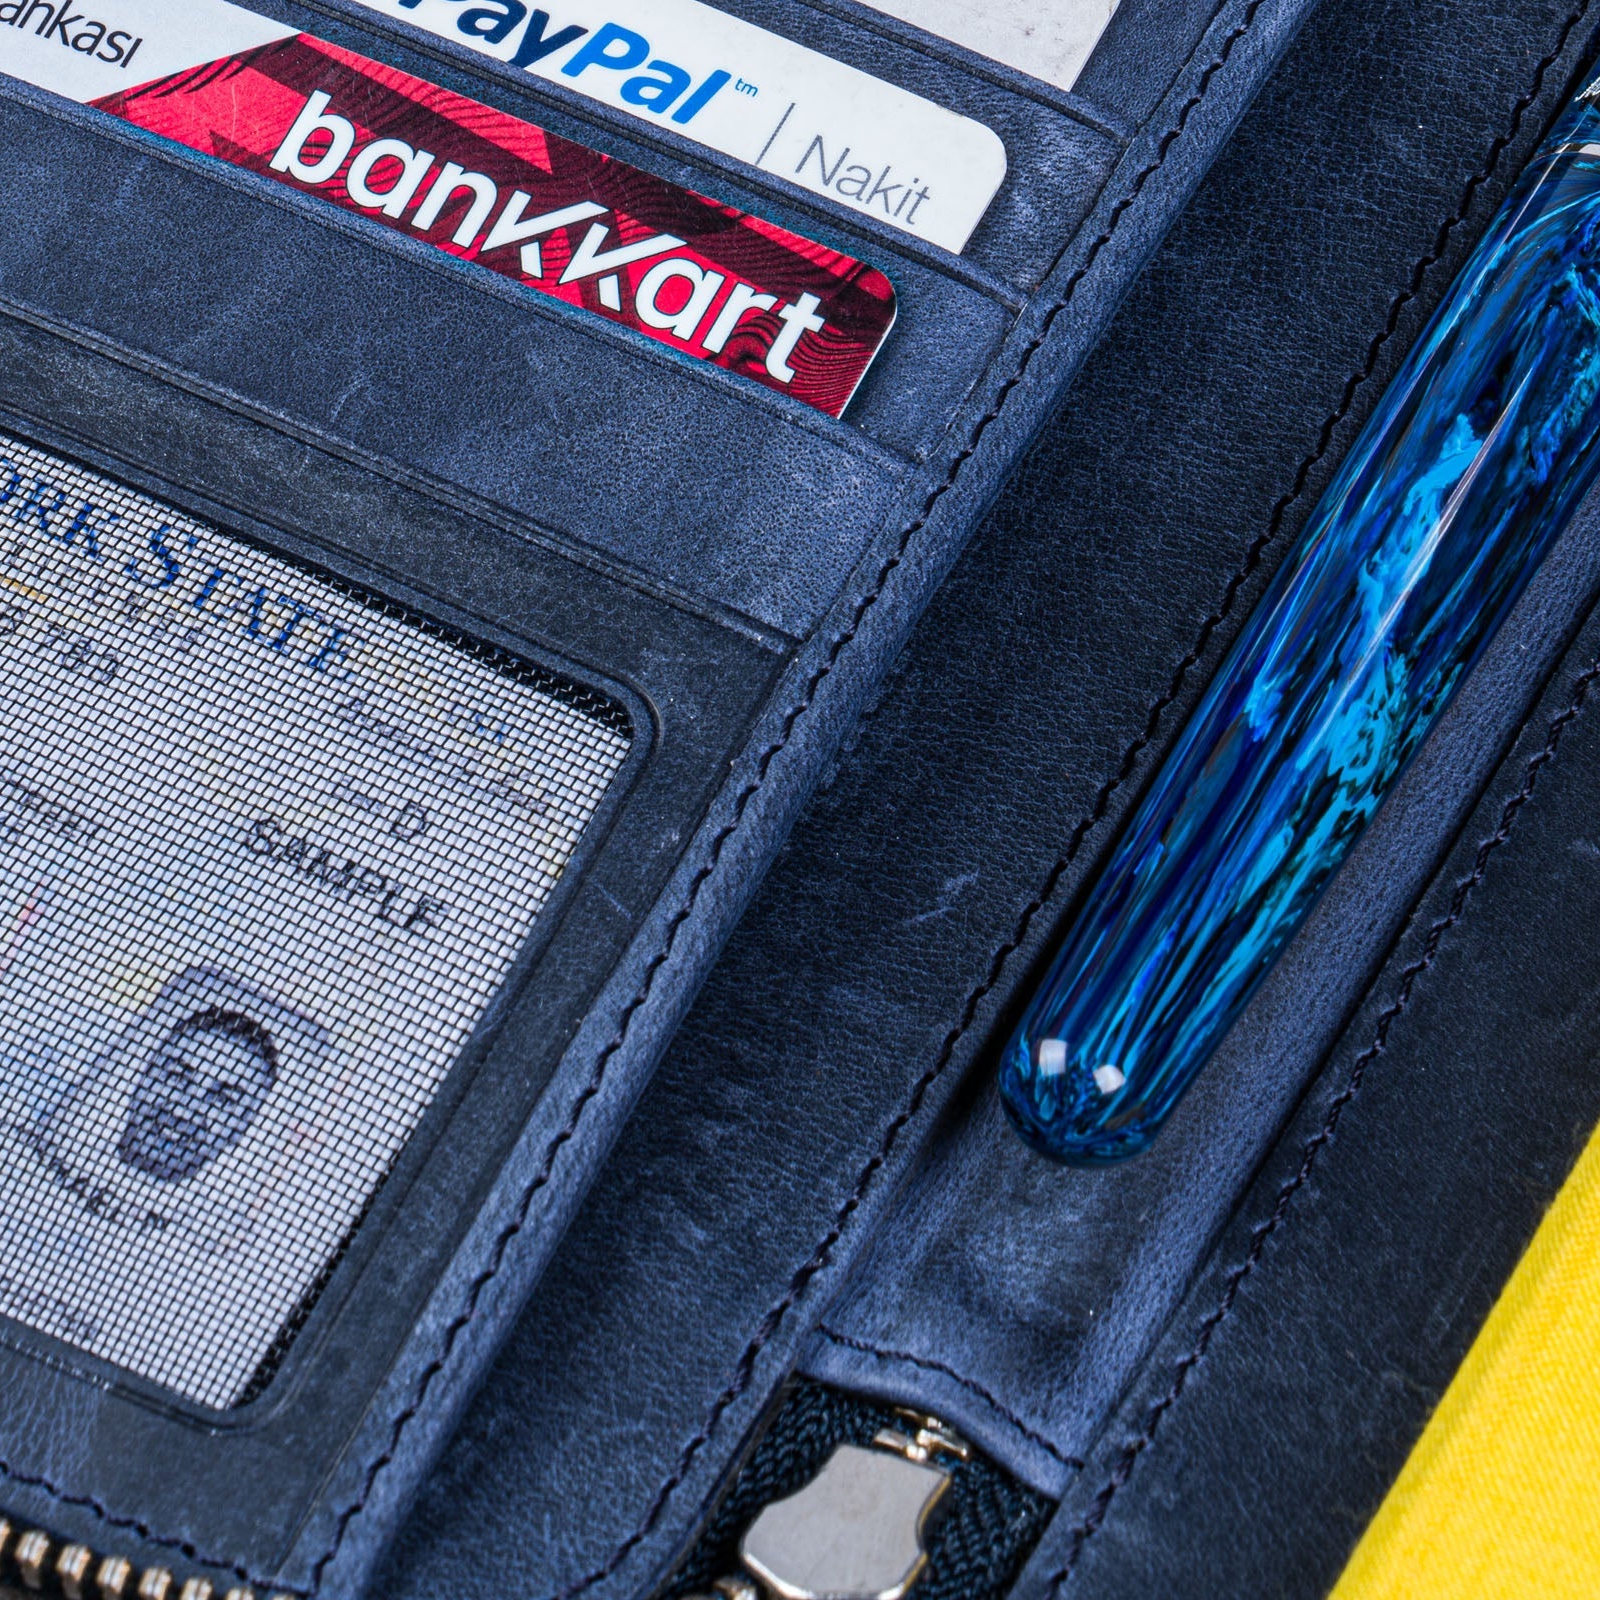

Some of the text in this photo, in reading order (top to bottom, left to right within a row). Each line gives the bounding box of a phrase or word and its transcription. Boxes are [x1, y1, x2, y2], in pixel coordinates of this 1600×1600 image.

[794, 133, 933, 226] Nakit
[125, 524, 369, 681] STATE
[238, 813, 450, 943] SAMPLE
